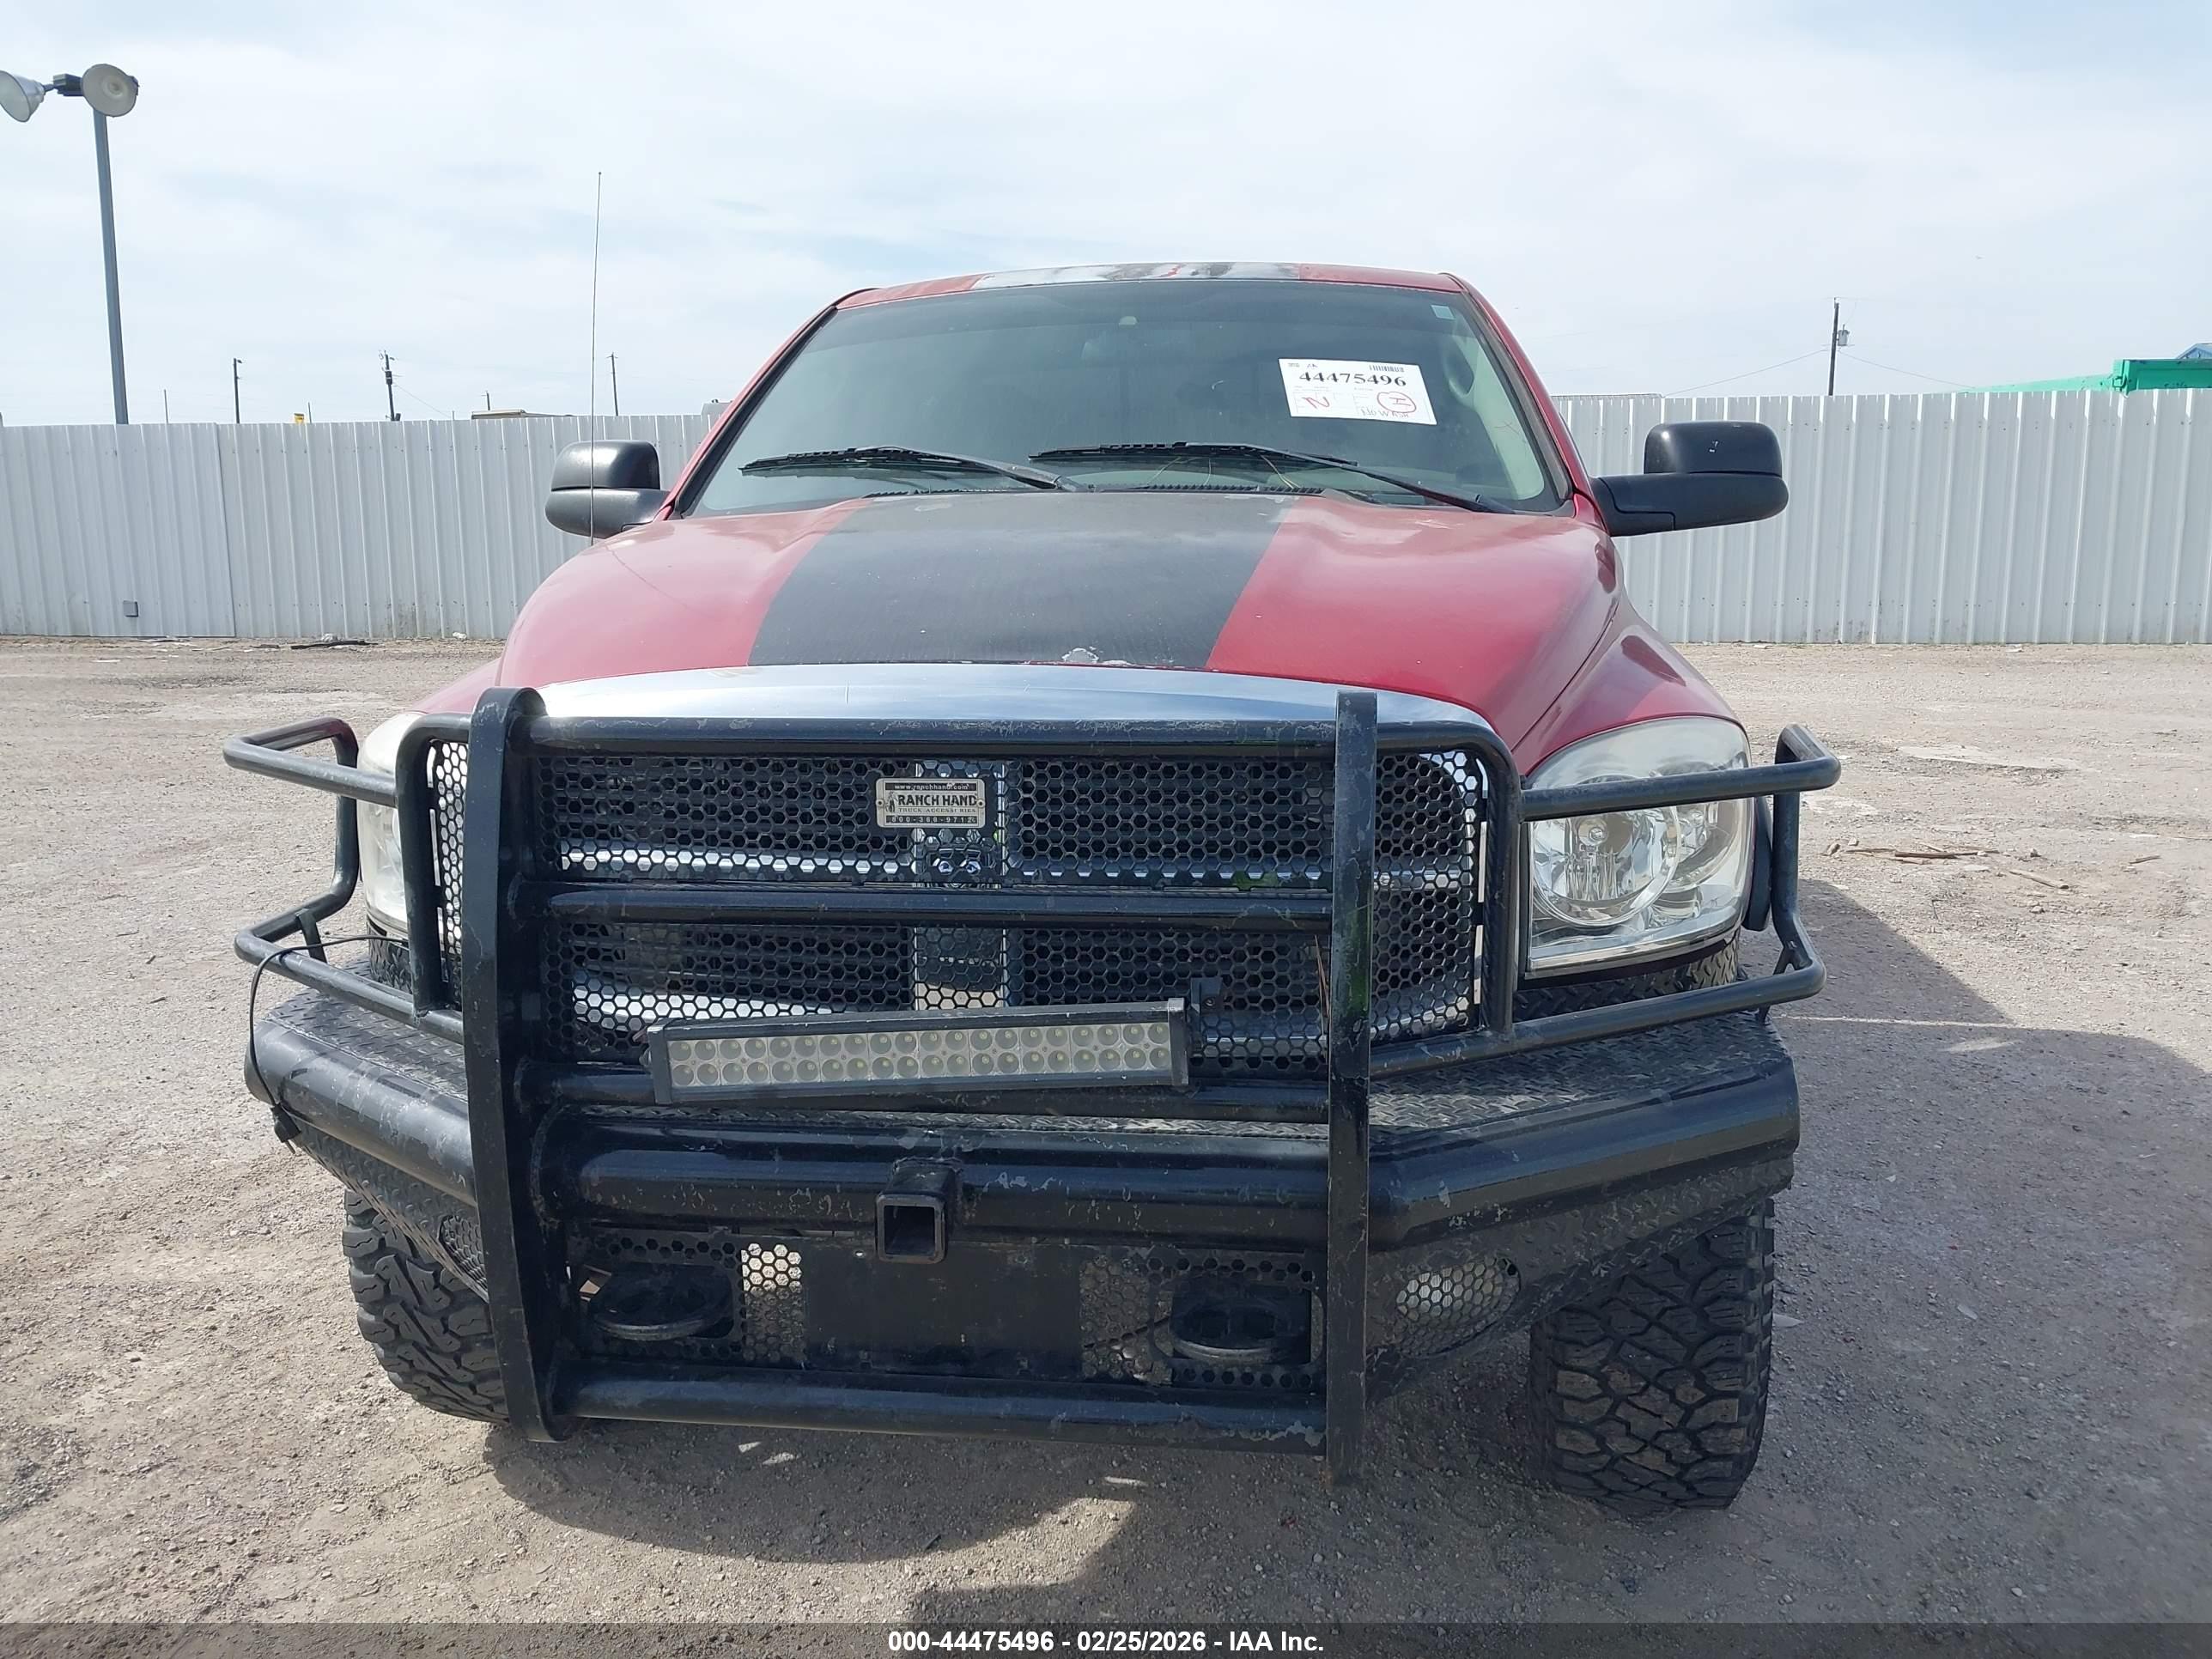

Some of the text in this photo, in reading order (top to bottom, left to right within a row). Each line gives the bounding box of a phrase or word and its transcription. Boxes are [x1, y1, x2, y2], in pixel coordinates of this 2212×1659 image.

[1299, 371, 1407, 387] 44475496
[897, 794, 977, 806] RANCH HAND
